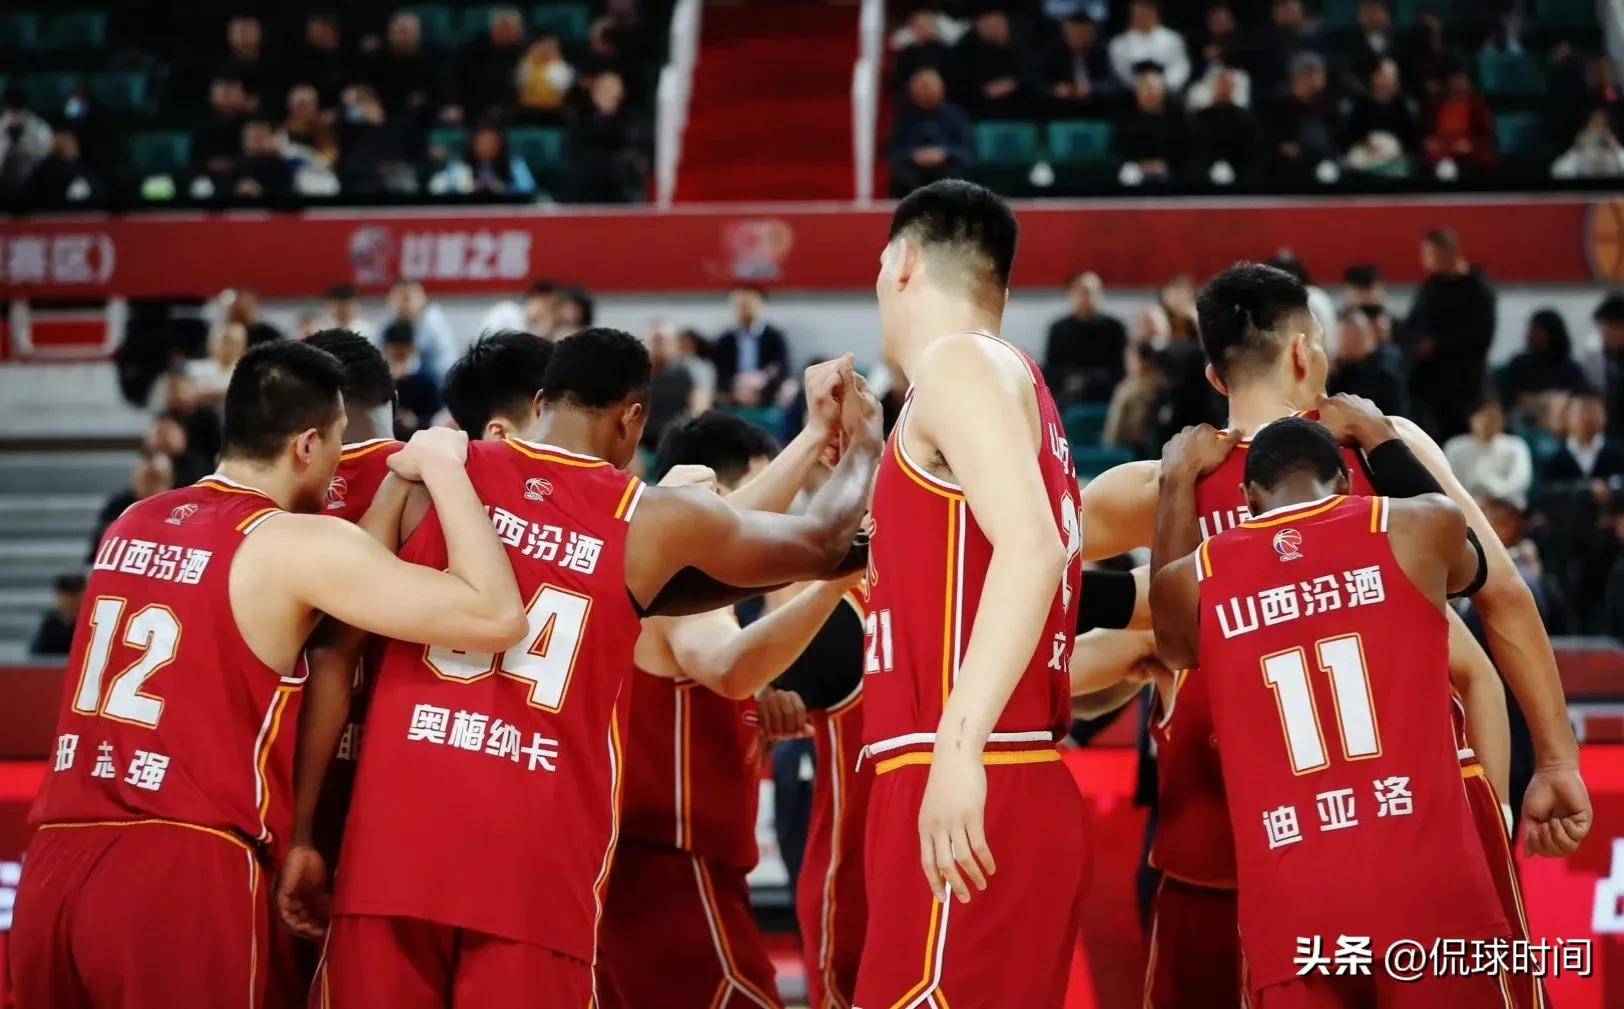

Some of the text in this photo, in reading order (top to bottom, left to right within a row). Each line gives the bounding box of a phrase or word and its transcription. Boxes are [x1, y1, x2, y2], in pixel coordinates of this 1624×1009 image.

[0, 234, 115, 284] 赛区)
[93, 536, 213, 584] 山西汾酒
[485, 505, 604, 575] 西汾酒
[1215, 565, 1386, 639] 山西汾酒
[71, 595, 182, 729] 12
[864, 608, 894, 674] 21
[407, 703, 559, 772] 奥梅纳卡
[1260, 632, 1382, 776] 11
[1262, 776, 1413, 850] 迪亚洛
